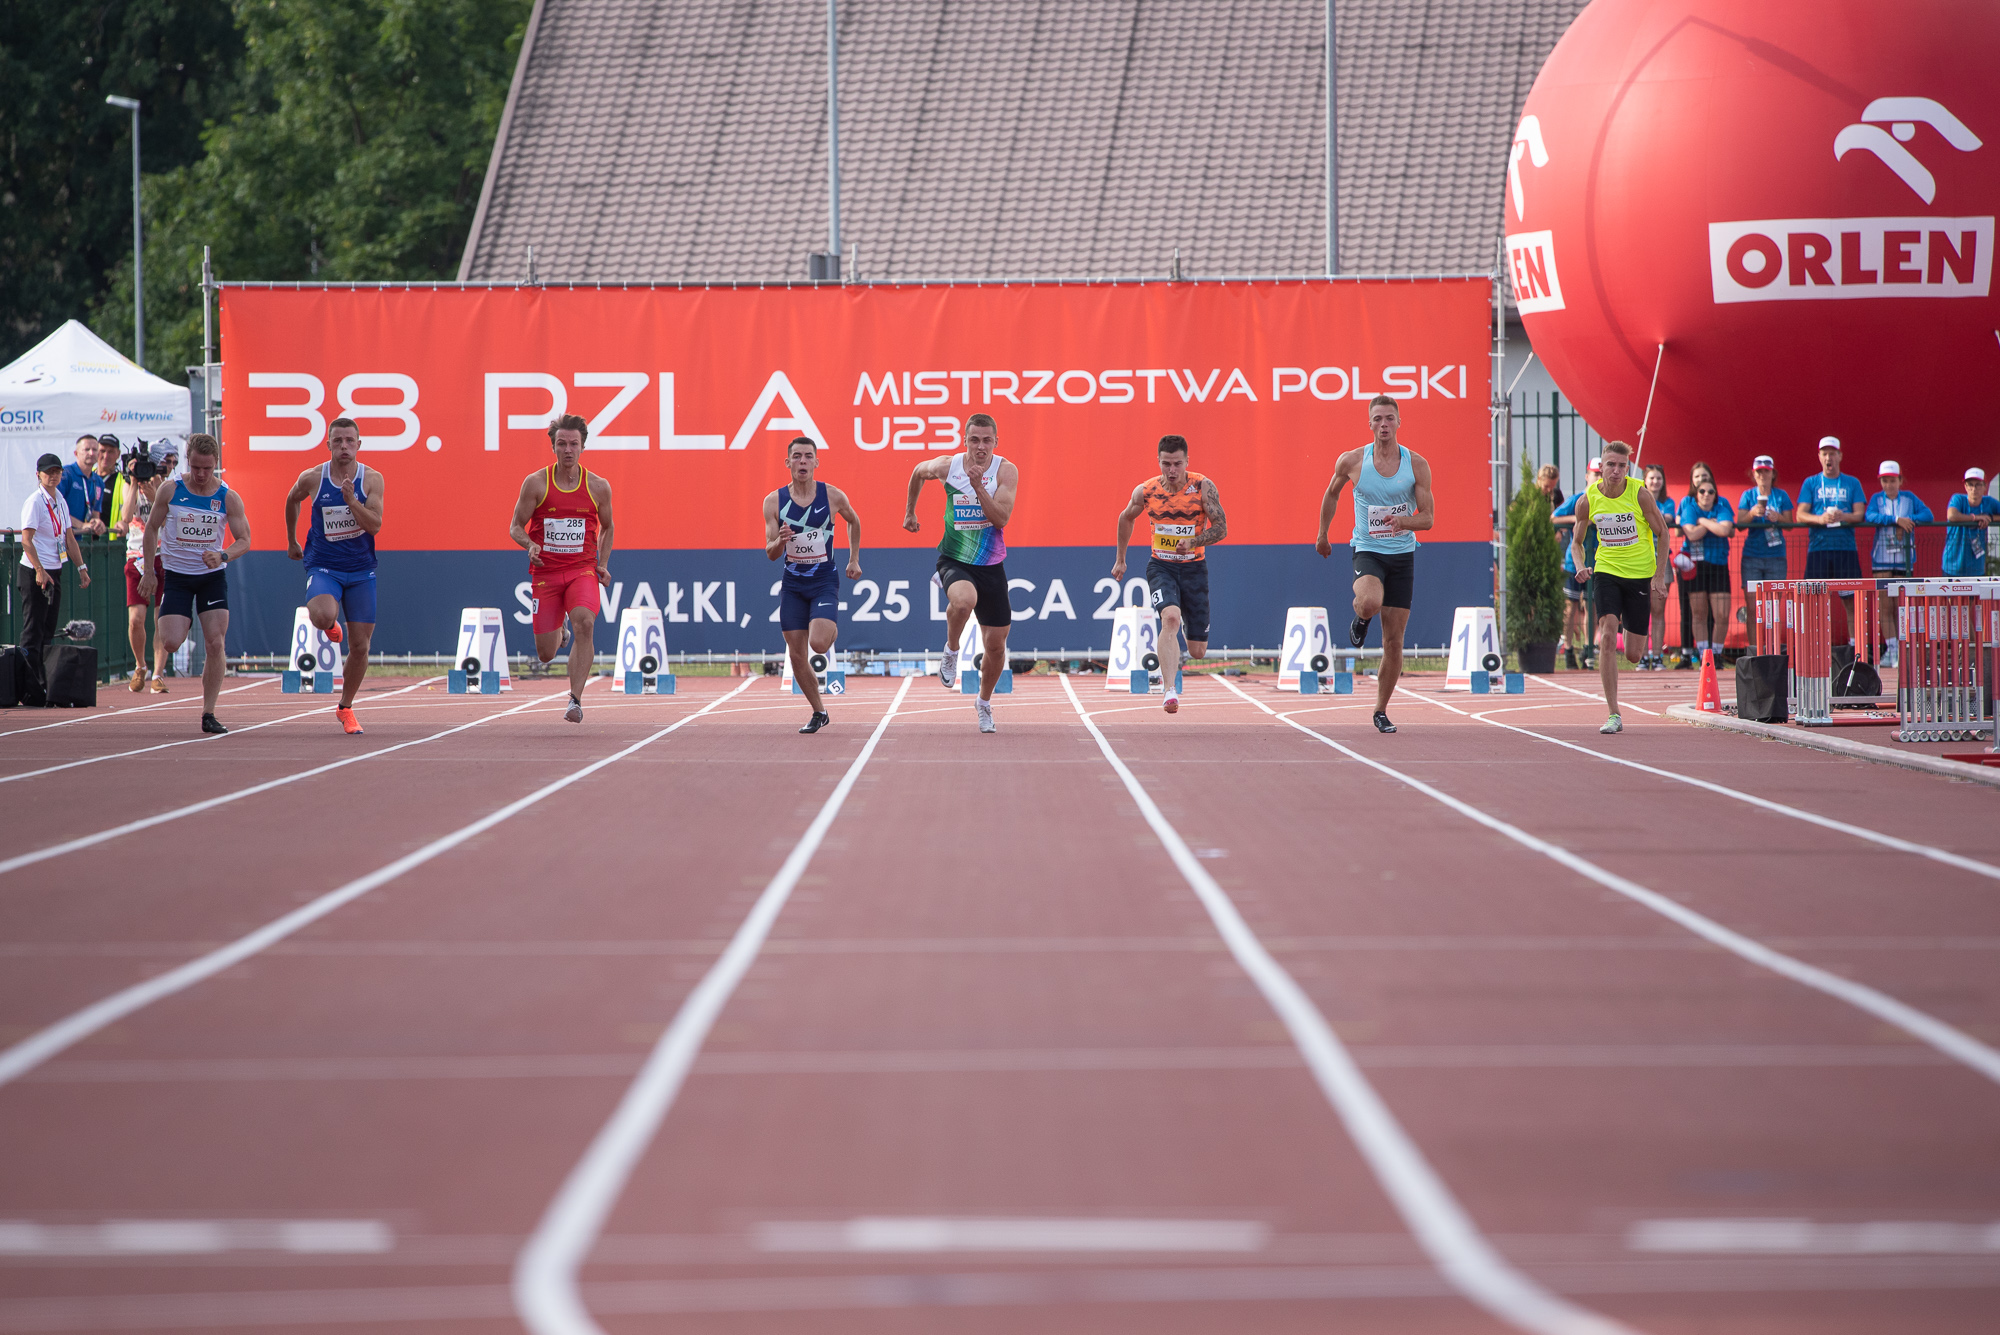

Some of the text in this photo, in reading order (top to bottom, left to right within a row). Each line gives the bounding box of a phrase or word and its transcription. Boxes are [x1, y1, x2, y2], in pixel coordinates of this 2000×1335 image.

[1726, 230, 1977, 289] ORLEN
[853, 364, 1467, 406] MISTRZOSTWA POLSKI
[0, 409, 44, 424] OSIR
[100, 408, 174, 423] Żyj aktywnie
[249, 370, 829, 452] 38. PZLA
[854, 416, 961, 451] U23
[1391, 504, 1407, 515] 268
[201, 515, 218, 524] 121
[325, 519, 359, 529] WYKRO
[566, 519, 583, 528] 285
[1615, 513, 1633, 523] 356
[182, 526, 213, 537] GOŁĄB
[546, 530, 584, 542] ŁĘCZYCKI
[806, 531, 818, 541] 99
[1175, 526, 1193, 535] 347
[1598, 525, 1635, 536] ZIELIŃSKI
[794, 545, 814, 554] ŻOK
[1770, 582, 1786, 590] 38.
[514, 581, 752, 628] SWAŁKI,
[930, 578, 1077, 621] LCA
[1152, 592, 1160, 604] 3
[463, 625, 476, 657] 7
[483, 624, 500, 672] 7
[622, 625, 637, 672] 6
[645, 625, 662, 671] 6
[961, 624, 977, 669] 4
[1115, 624, 1131, 671] 3
[1287, 624, 1306, 671] 2
[1457, 623, 1470, 671] 1
[317, 629, 336, 671] 8
[831, 682, 841, 693] 5
